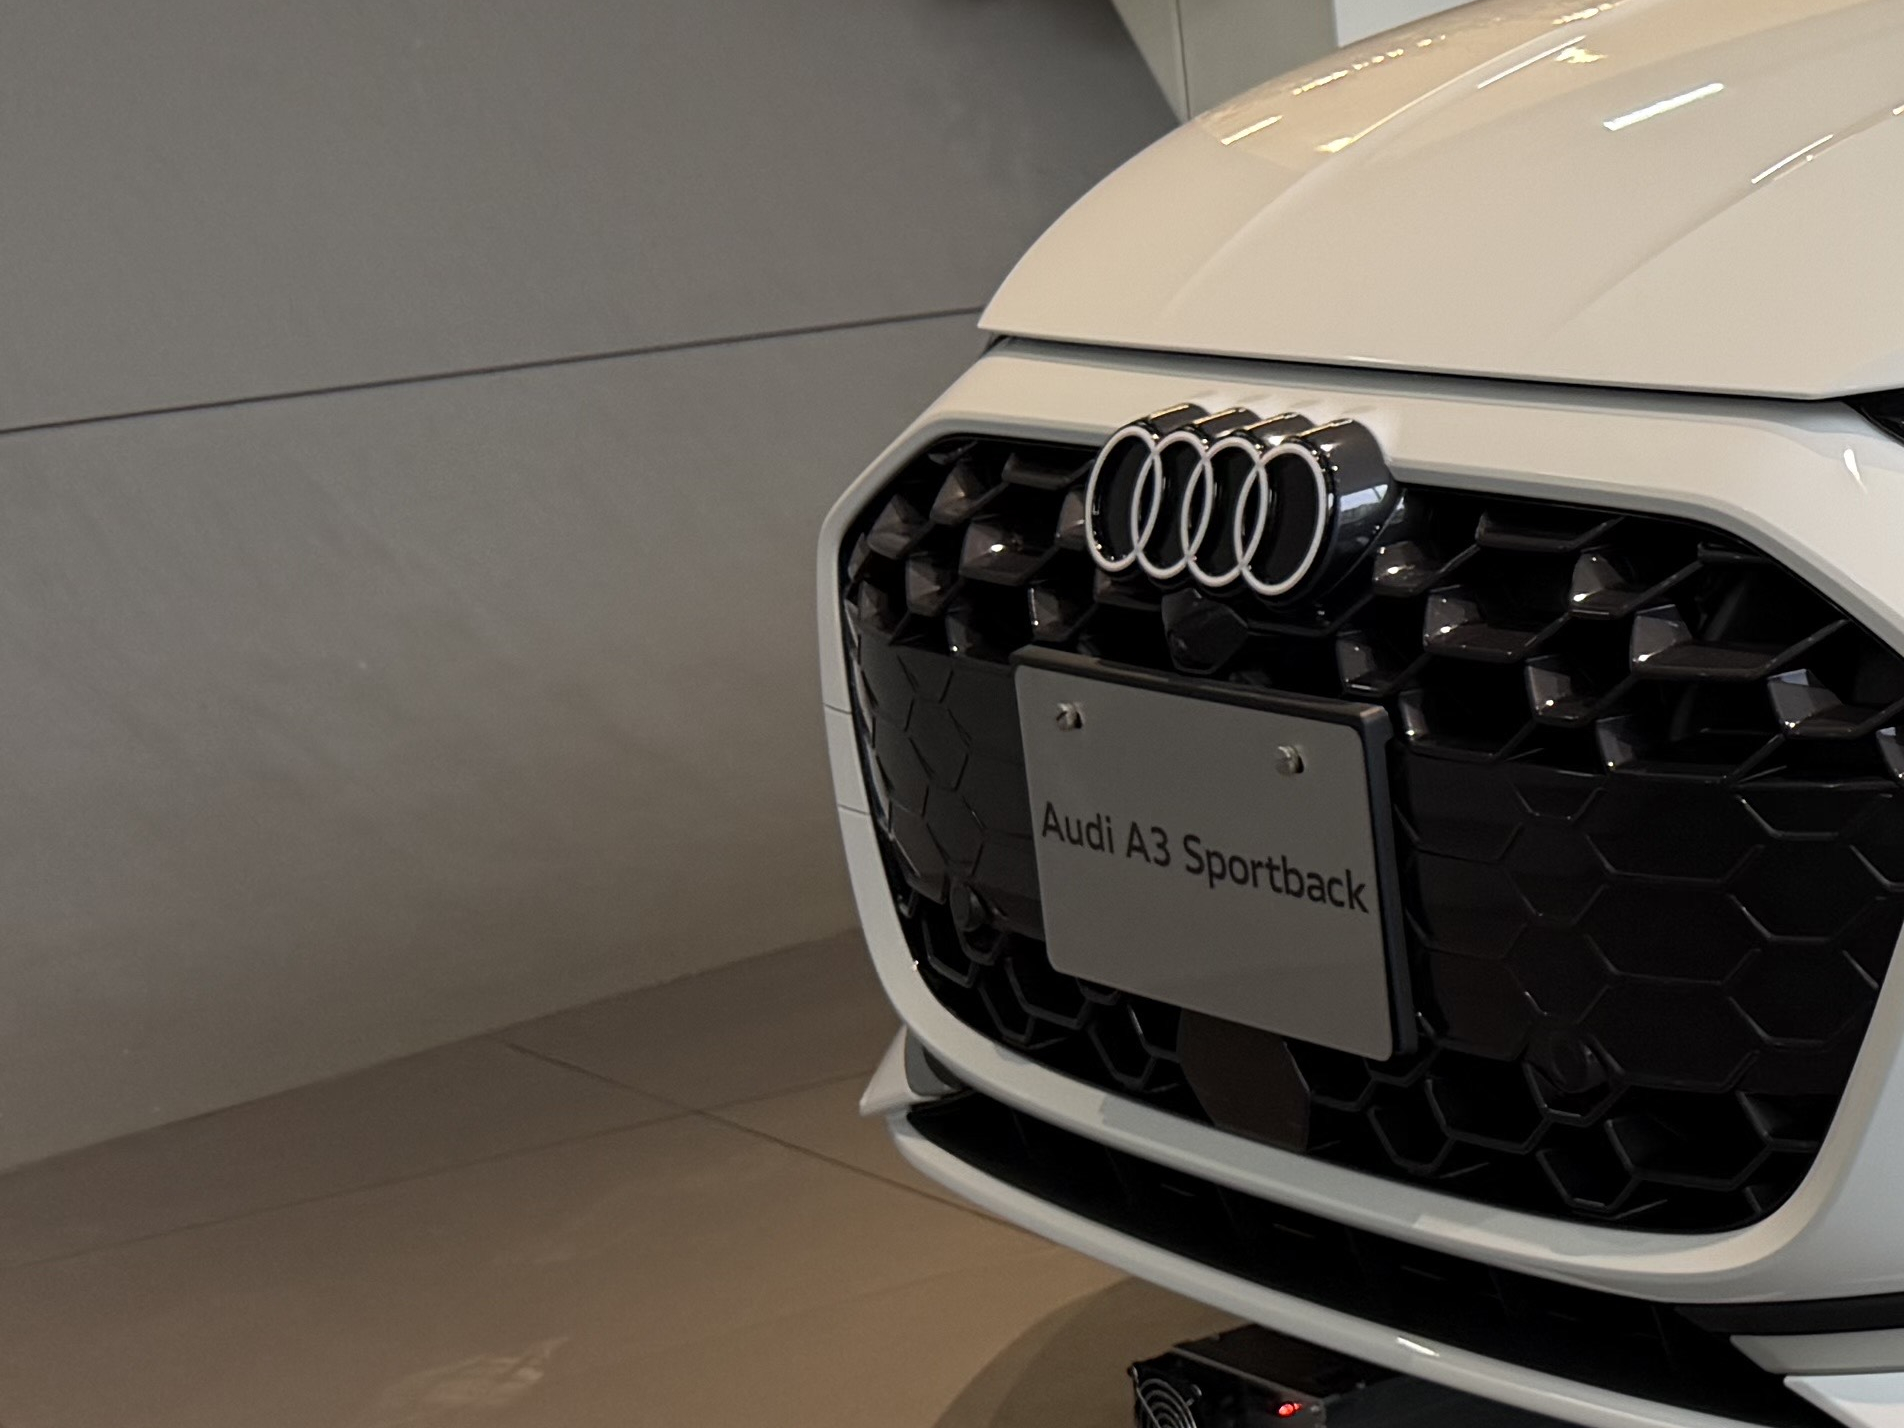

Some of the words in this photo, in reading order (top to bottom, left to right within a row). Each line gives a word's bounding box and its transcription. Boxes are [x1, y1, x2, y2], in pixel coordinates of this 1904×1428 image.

[1041, 801, 1114, 854] Audi
[1126, 820, 1172, 867] A3
[1183, 834, 1370, 914] Sportback
